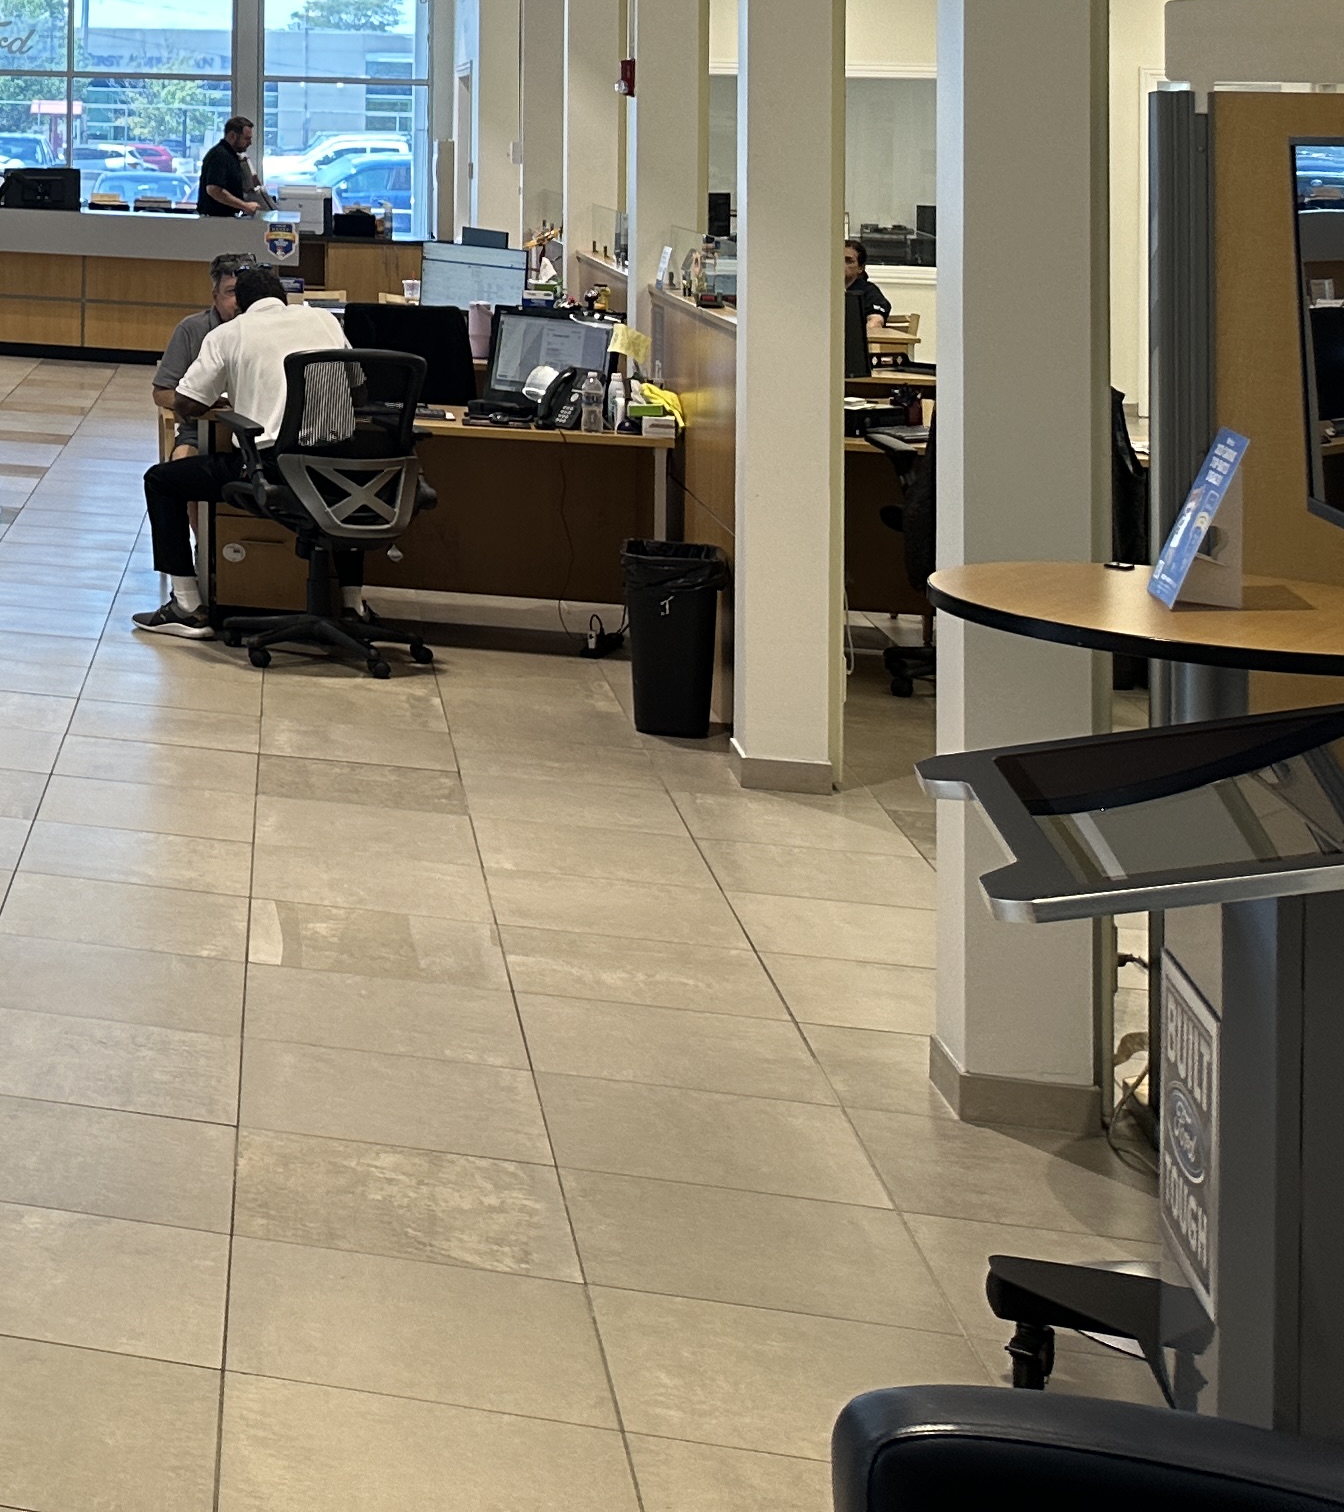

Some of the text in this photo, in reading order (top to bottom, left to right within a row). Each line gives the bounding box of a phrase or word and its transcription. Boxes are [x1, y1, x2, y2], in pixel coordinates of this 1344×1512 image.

[1167, 993, 1210, 1112] BUILT
[1173, 1099, 1197, 1163] Ford
[1165, 1150, 1208, 1270] TOUGH
